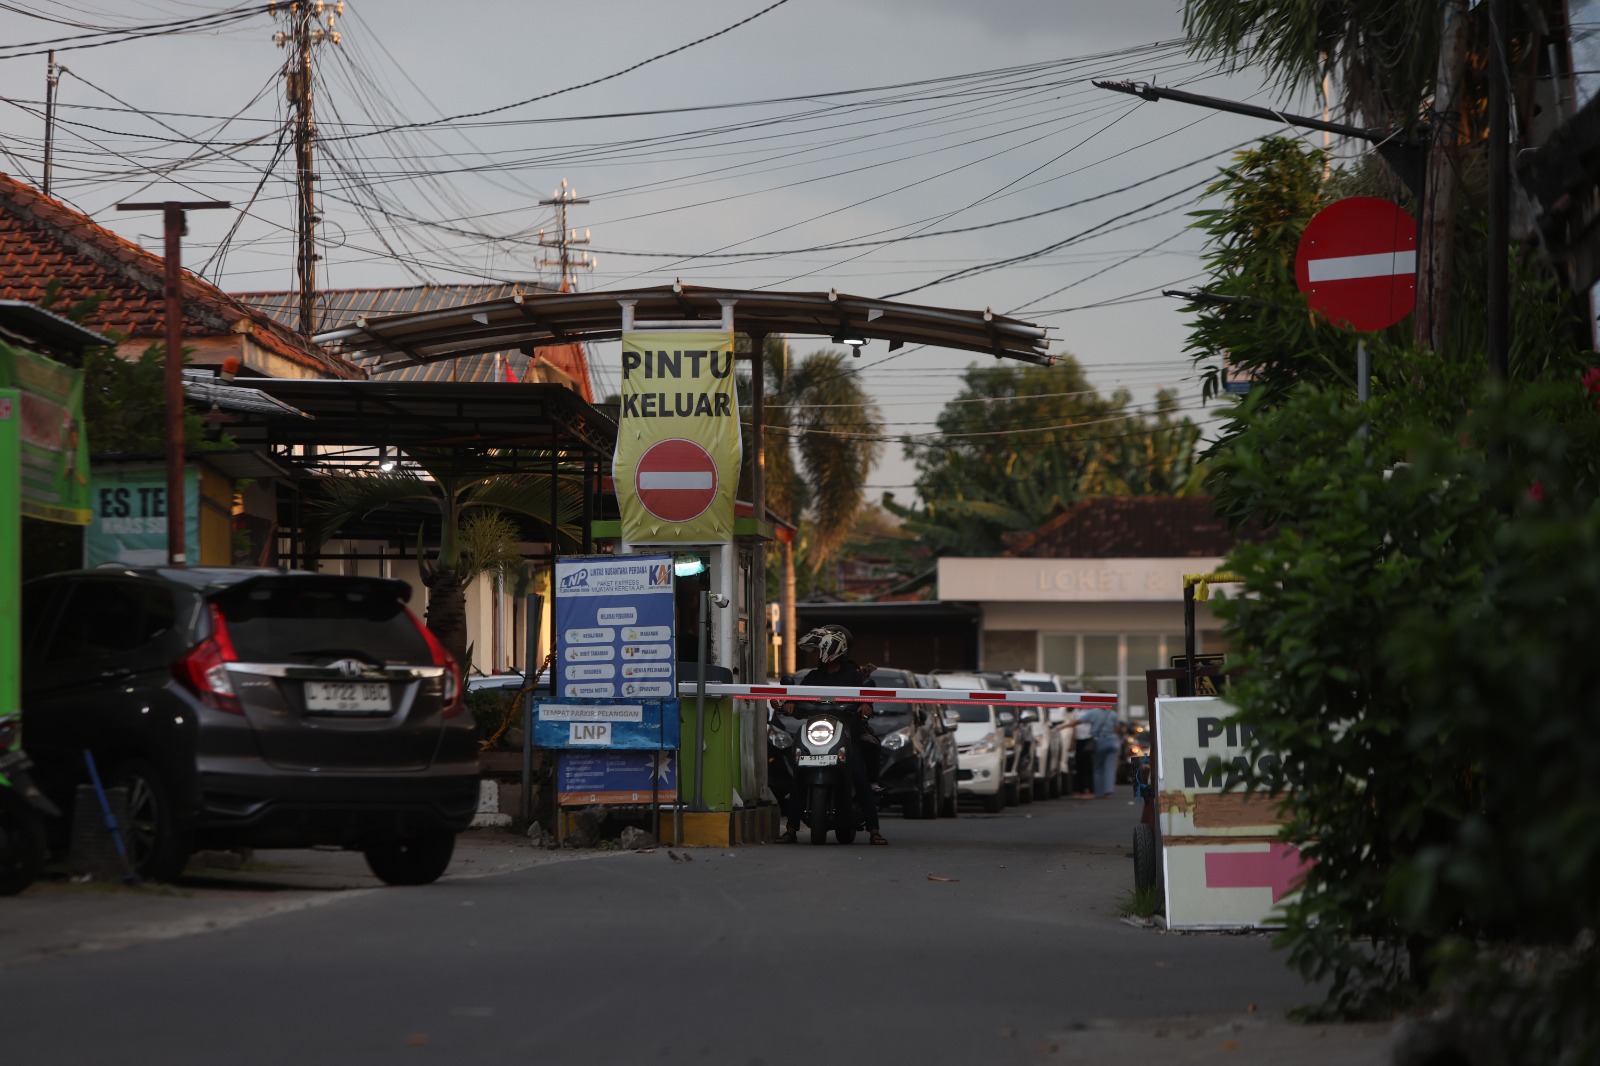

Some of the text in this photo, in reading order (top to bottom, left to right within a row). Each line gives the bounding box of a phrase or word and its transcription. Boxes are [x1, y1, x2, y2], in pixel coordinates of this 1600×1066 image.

[622, 350, 734, 379] PINTU
[622, 392, 731, 418] KELUAR
[100, 487, 130, 518] ES
[138, 487, 166, 518] TE
[560, 568, 588, 588] LNP
[604, 567, 628, 576] NUSANTARA
[628, 566, 647, 575] PERDANA
[648, 564, 672, 585] KAI
[1036, 568, 1133, 592] LOKET
[542, 709, 639, 718] TEMPAT PARKIR PELANGGAN
[573, 725, 607, 740] LNP
